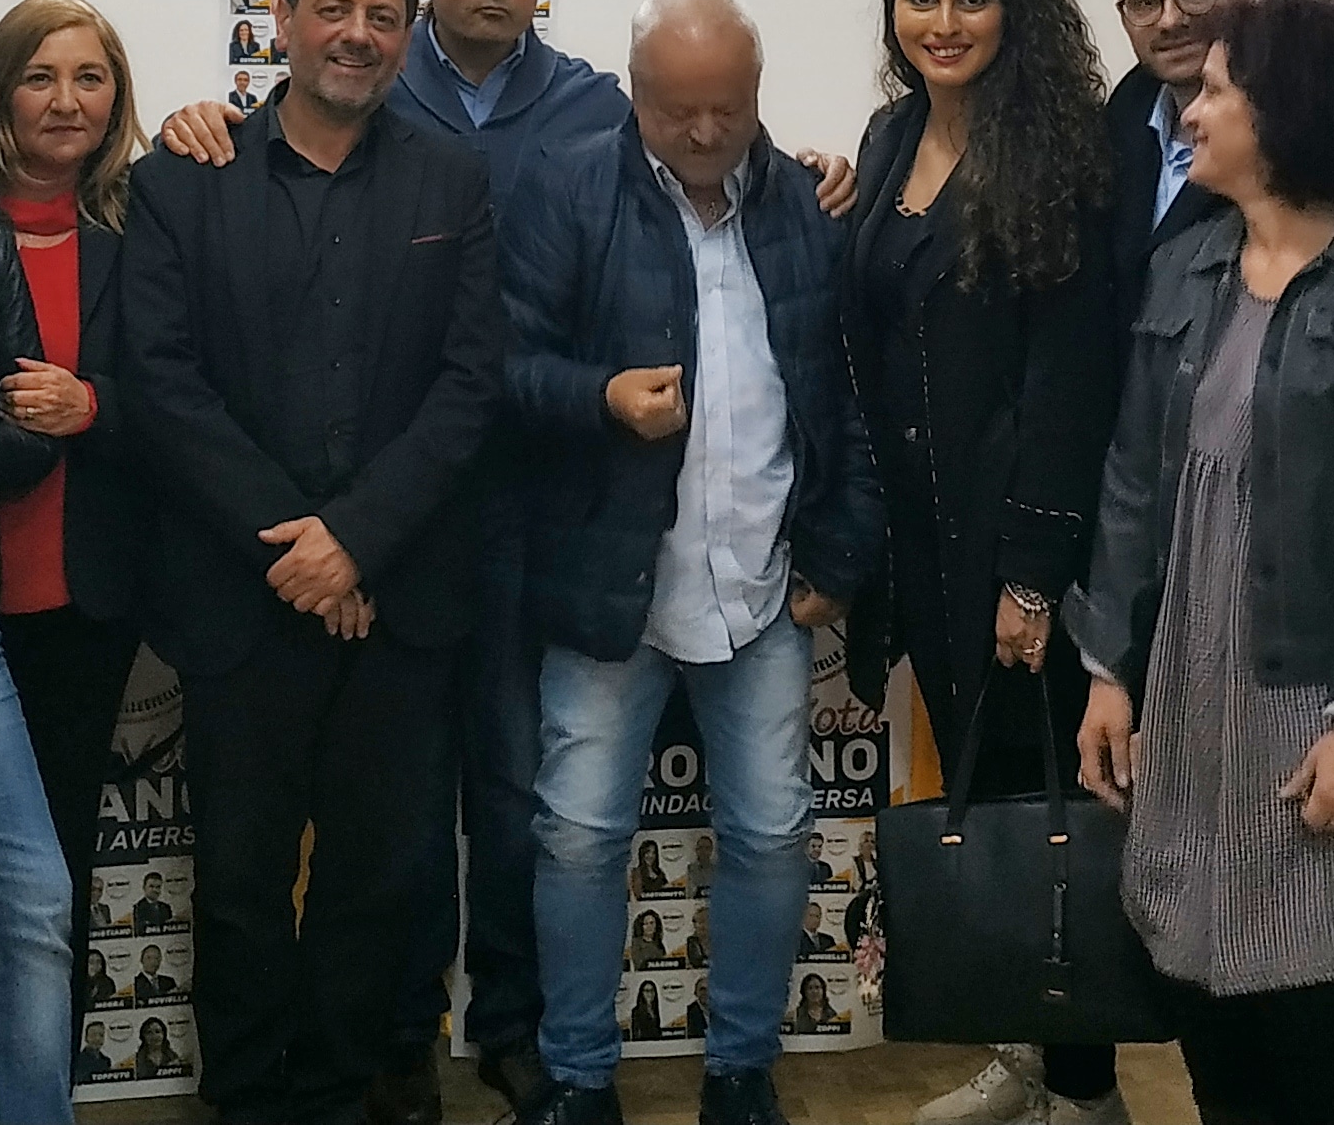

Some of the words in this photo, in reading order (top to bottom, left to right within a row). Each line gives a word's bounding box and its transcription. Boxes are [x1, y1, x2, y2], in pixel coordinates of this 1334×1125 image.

[811, 698, 883, 734] ota
[640, 791, 714, 815] INDAC
[810, 787, 874, 810] ERSA
[108, 825, 197, 851] AVERS
